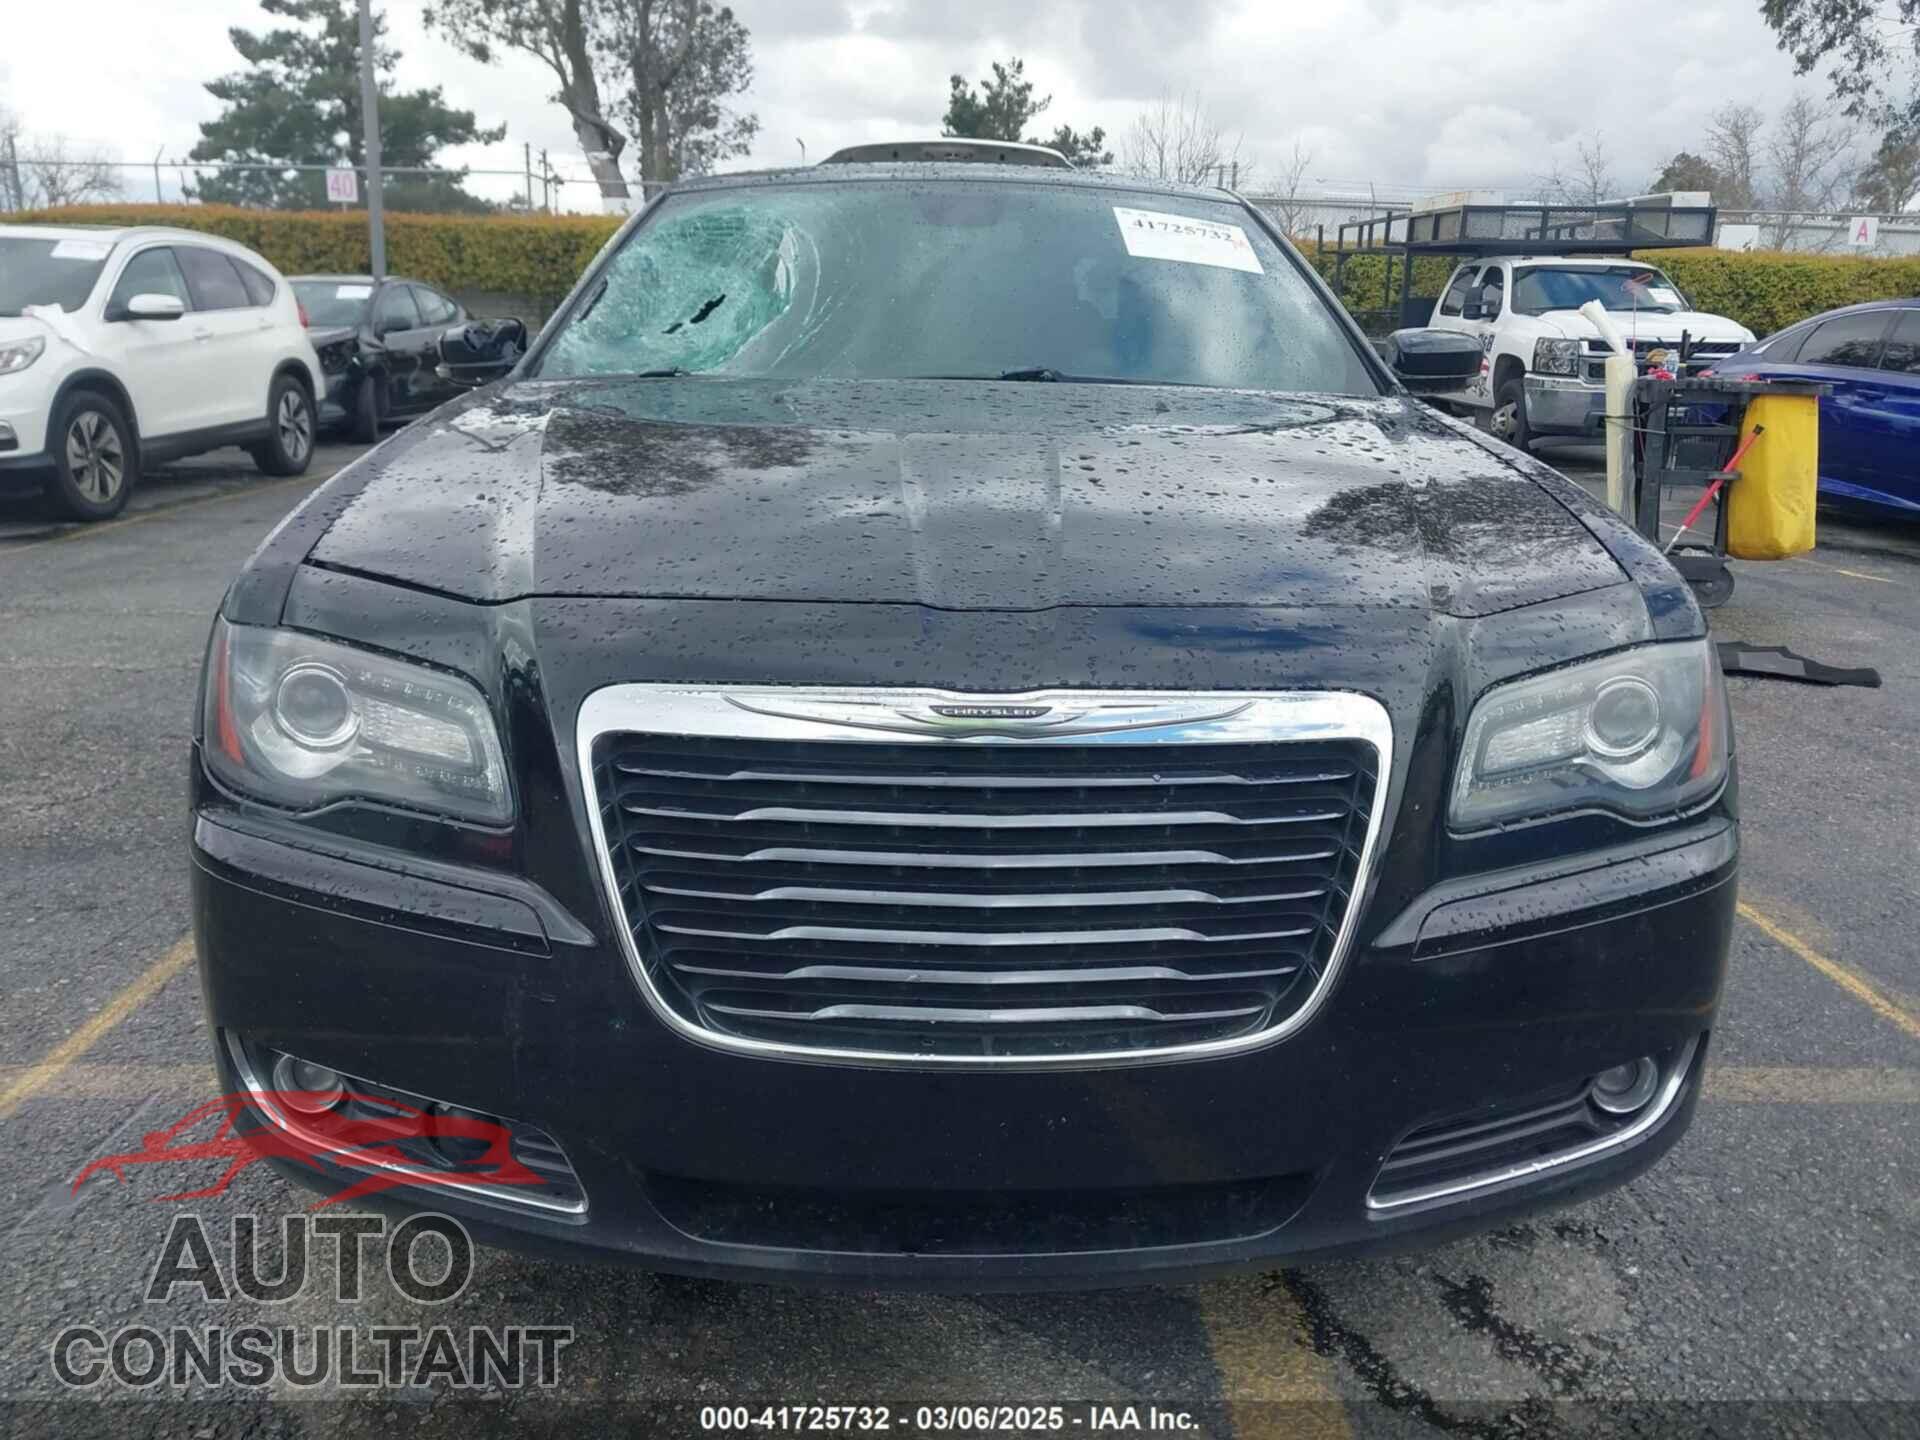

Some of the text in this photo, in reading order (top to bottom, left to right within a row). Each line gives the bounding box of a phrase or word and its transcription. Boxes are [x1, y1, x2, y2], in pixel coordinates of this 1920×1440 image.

[331, 173, 353, 197] 40
[1855, 219, 1868, 243] A
[941, 707, 1038, 716] CHRYSLER
